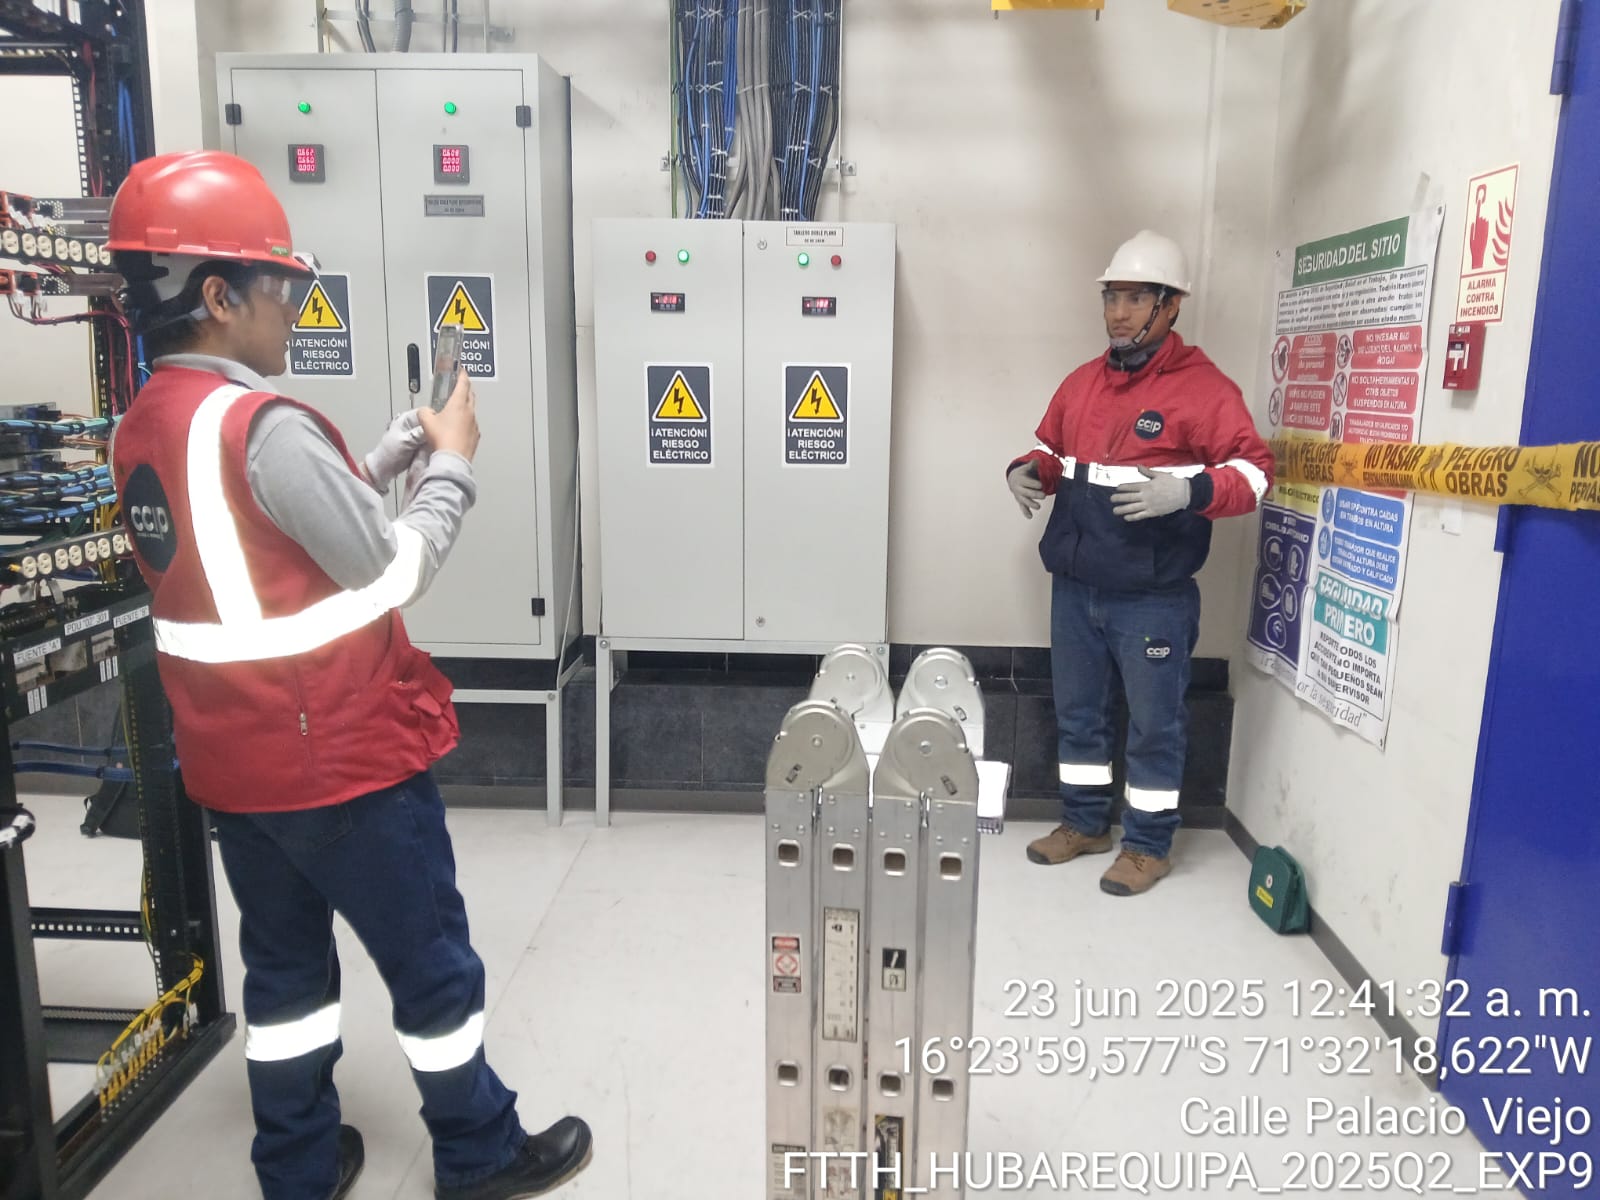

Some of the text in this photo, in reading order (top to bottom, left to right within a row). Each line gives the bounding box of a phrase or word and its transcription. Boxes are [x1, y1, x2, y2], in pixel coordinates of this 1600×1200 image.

[1298, 233, 1401, 275] SEGURIDAD DEL SITIO
[1467, 278, 1496, 290] ALARMA
[1466, 292, 1495, 304] CONTRA
[1460, 304, 1499, 318] INCENDIOS
[302, 350, 340, 359] RIESGO
[460, 352, 482, 361] SGO
[294, 360, 349, 370] ELÉCTRICO
[462, 362, 492, 373] TRICO
[661, 439, 699, 449] RIESGO
[797, 439, 835, 449] RIESGO
[653, 449, 708, 460] ELÉCTRICO
[788, 449, 844, 460] ELÉCTRICO
[1301, 444, 1342, 465] PELIGRO
[1364, 444, 1427, 472] NO PASAR
[1443, 445, 1522, 472] PELIGRO
[1303, 463, 1335, 483] OBRAS
[1445, 471, 1509, 498] OBRAS
[1365, 518, 1373, 528] EN
[1340, 646, 1363, 661] ODOS
[1364, 654, 1377, 669] LOS
[1352, 662, 1381, 685] IMPORTA
[1366, 682, 1383, 700] SEAN
